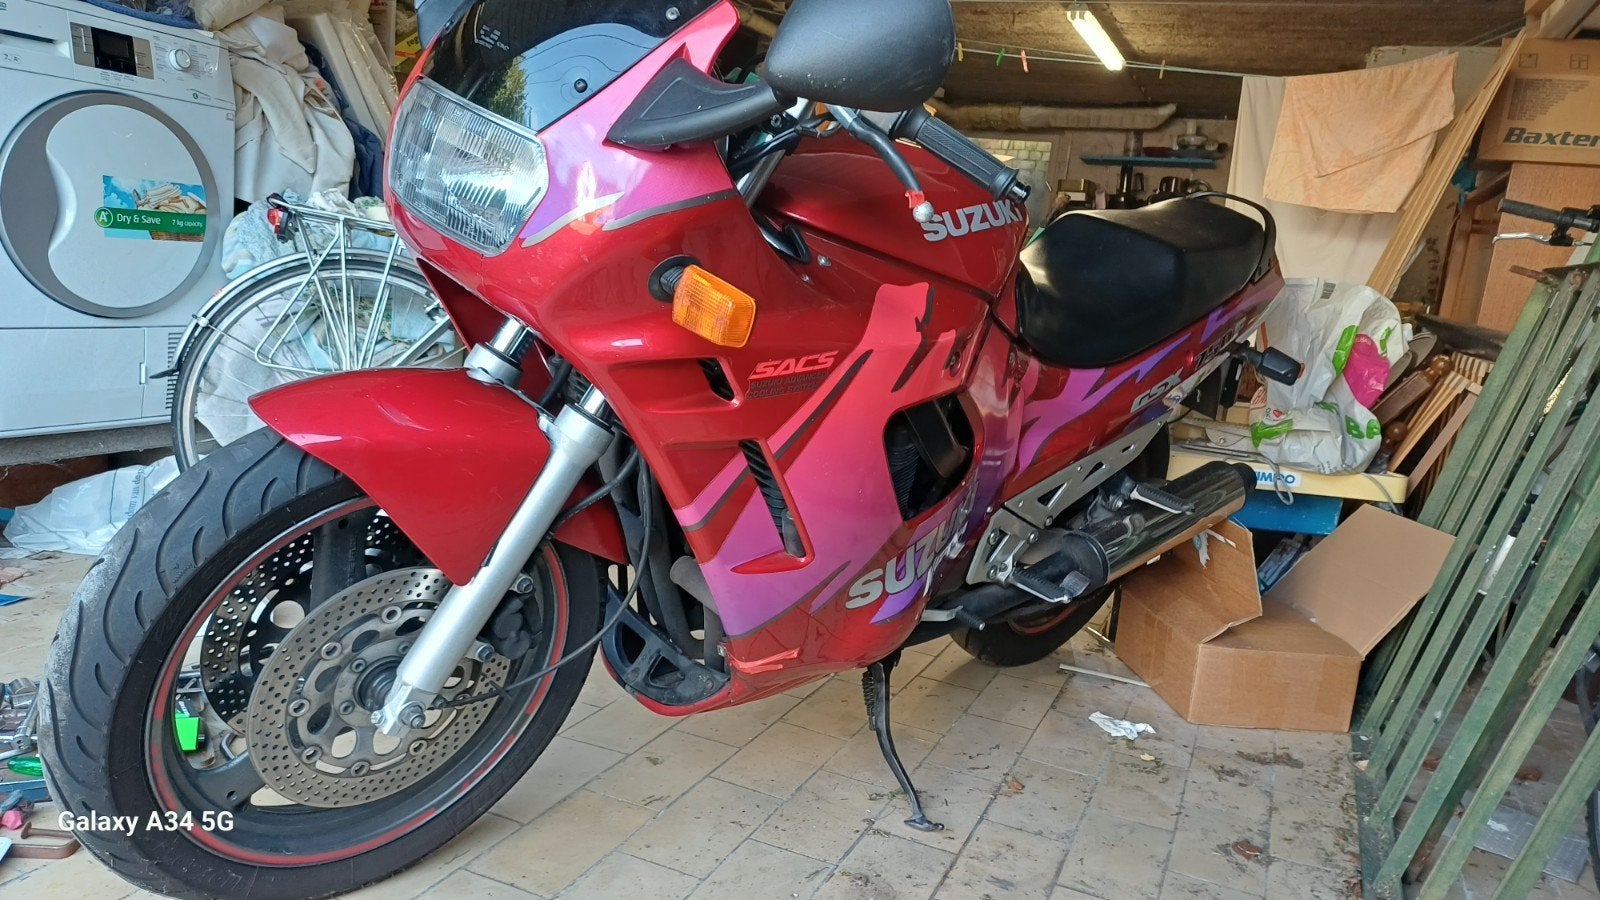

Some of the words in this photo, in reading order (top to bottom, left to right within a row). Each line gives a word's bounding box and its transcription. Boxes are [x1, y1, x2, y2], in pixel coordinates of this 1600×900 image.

[1503, 126, 1600, 148] Baxter
[116, 213, 132, 225] Dry
[133, 214, 140, 223] &
[141, 214, 161, 225] Save
[176, 219, 184, 228] kg
[920, 198, 1024, 242] SUZUKI
[747, 350, 839, 380] SACS
